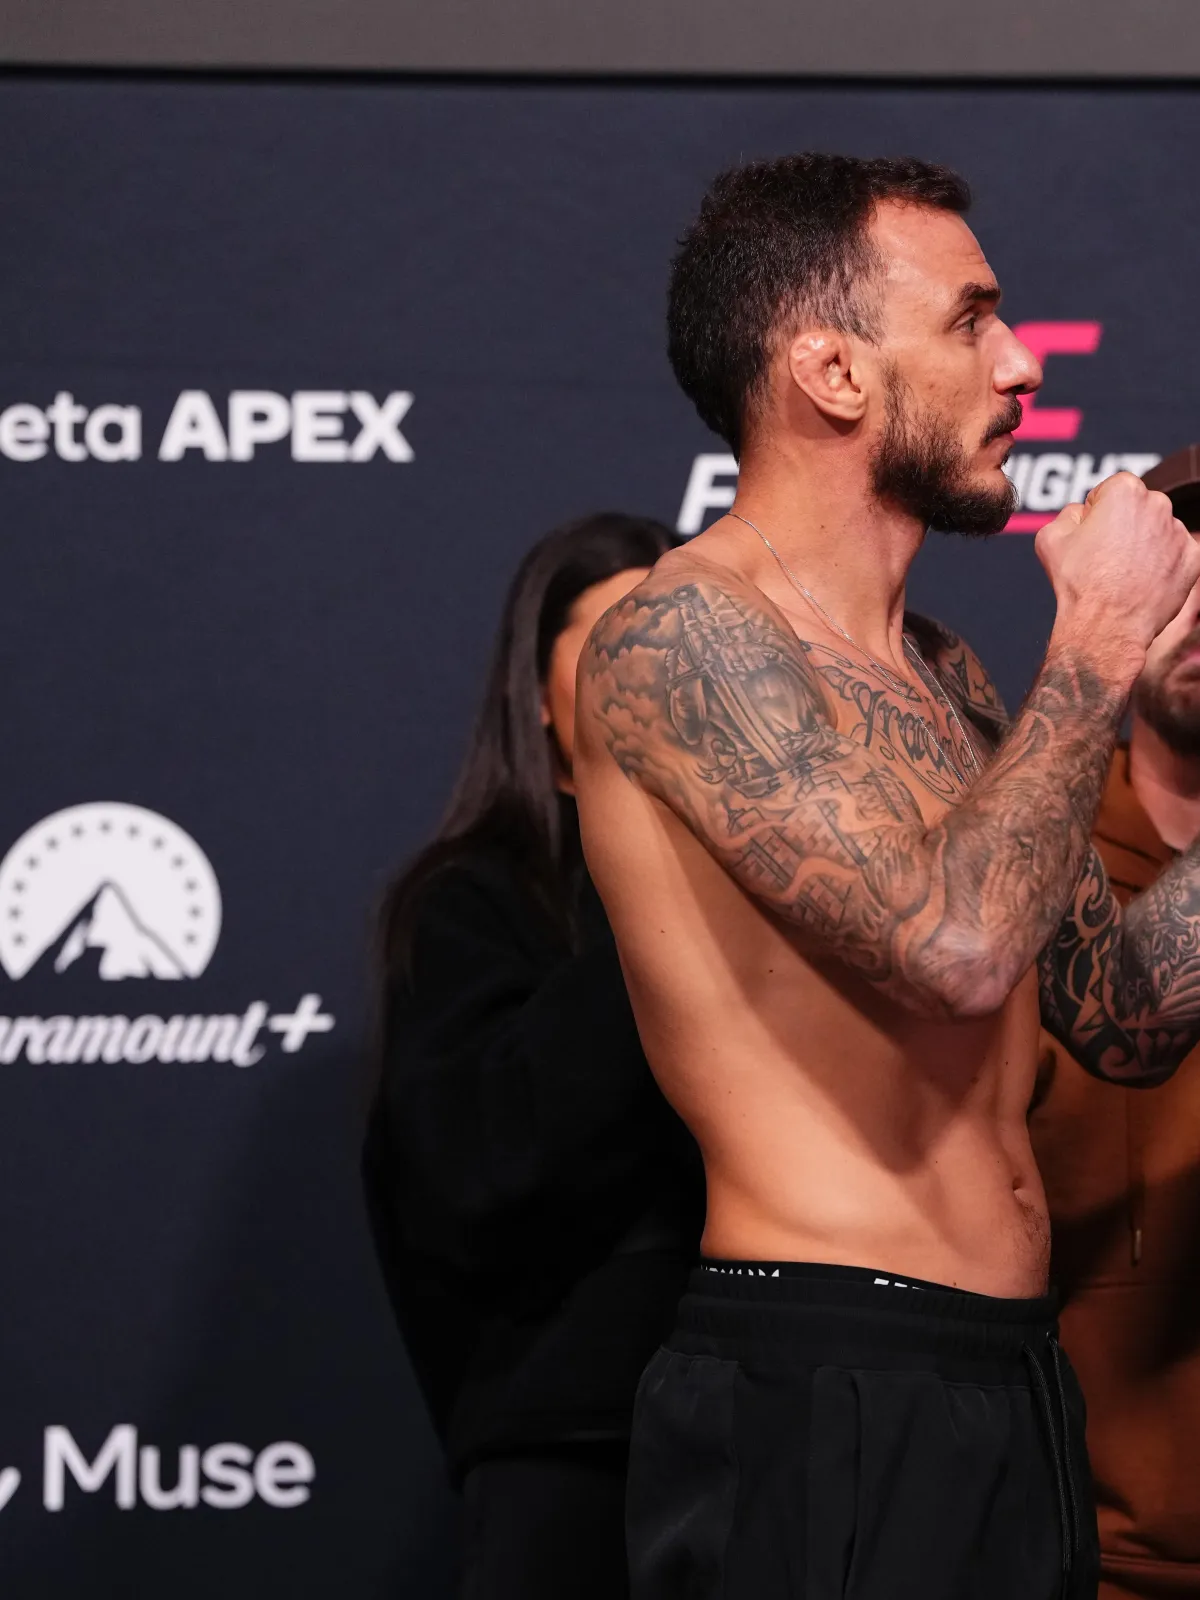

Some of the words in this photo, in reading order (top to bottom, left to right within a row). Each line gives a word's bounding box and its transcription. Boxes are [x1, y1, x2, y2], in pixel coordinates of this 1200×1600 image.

[157, 389, 415, 463] APEX
[1000, 453, 1162, 512] IGHT
[0, 993, 336, 1068] ramount+
[42, 1423, 316, 1512] Muse
